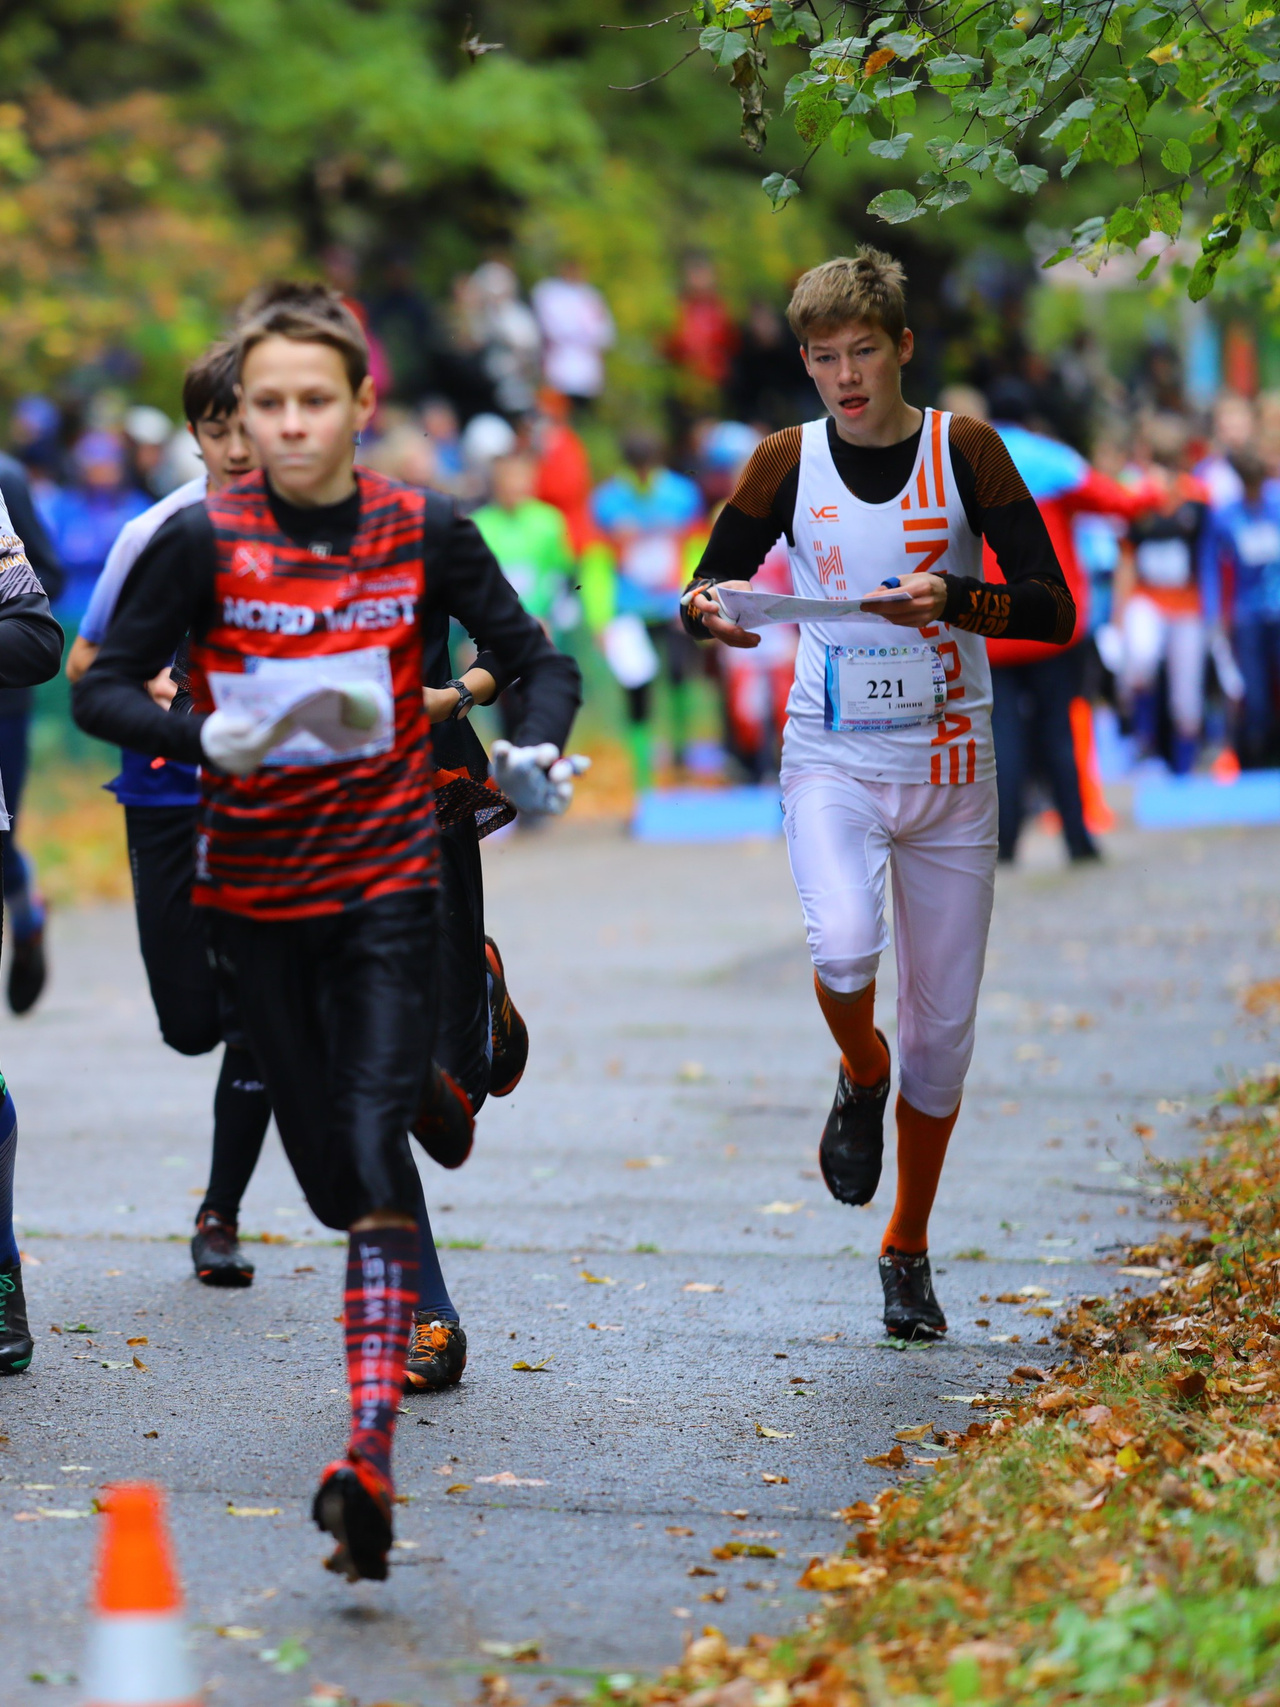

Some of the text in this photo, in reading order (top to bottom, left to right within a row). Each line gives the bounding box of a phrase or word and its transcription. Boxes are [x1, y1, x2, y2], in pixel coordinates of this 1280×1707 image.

[223, 594, 418, 636] NORD WEST
[866, 678, 905, 699] 221
